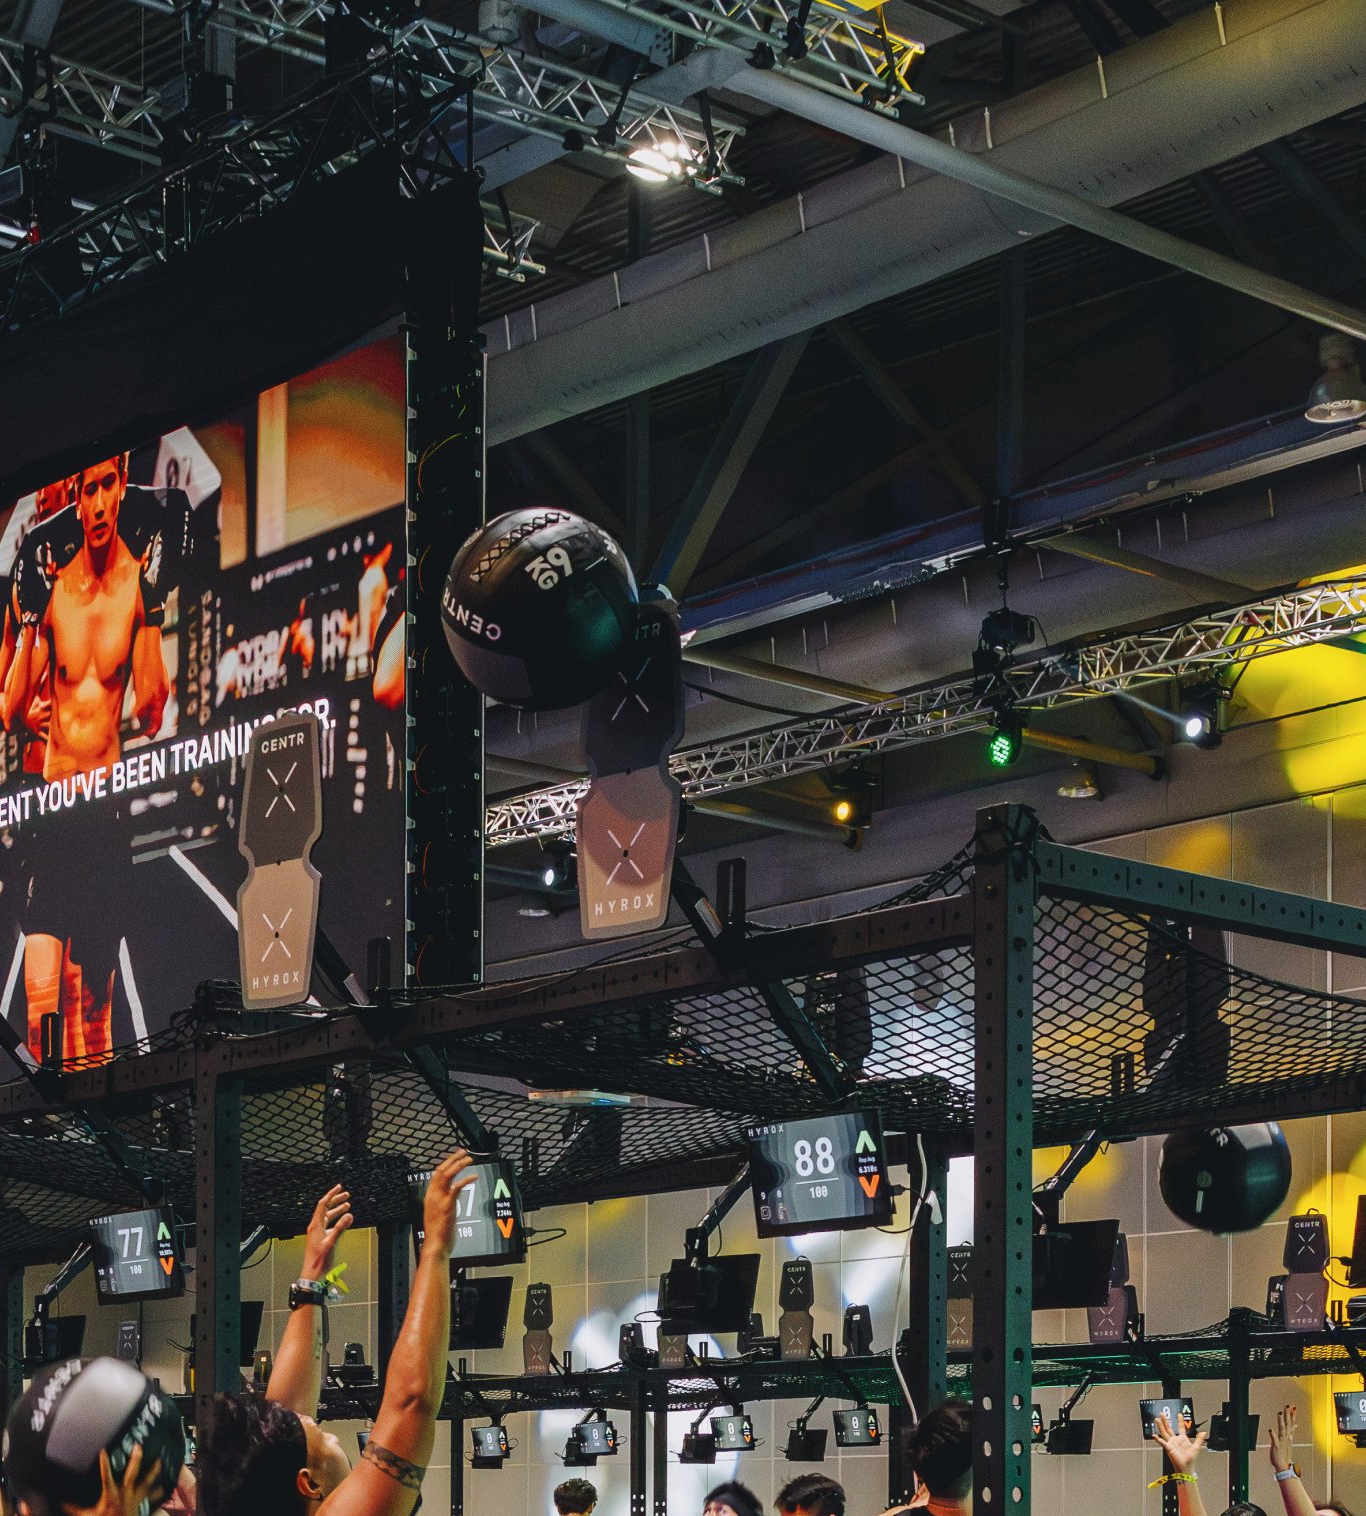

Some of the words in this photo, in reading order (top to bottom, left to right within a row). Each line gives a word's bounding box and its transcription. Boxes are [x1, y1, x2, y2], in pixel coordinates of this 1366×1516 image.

[525, 555, 559, 590] KG
[442, 587, 502, 641] CENTR
[261, 731, 305, 754] CENTR
[36, 767, 107, 816] YOU'VE
[112, 748, 166, 794] BEEN
[594, 893, 655, 915] HYROX
[252, 970, 300, 990] HYROX
[747, 1124, 784, 1137] HYROX
[794, 1137, 835, 1176] 88
[809, 1185, 828, 1199] 100
[457, 1226, 473, 1238] 100
[1295, 1221, 1320, 1229] CENTR
[117, 1226, 143, 1258] 77
[129, 1264, 143, 1275] 100
[727, 1422, 735, 1435] 0
[851, 1416, 859, 1429] 0
